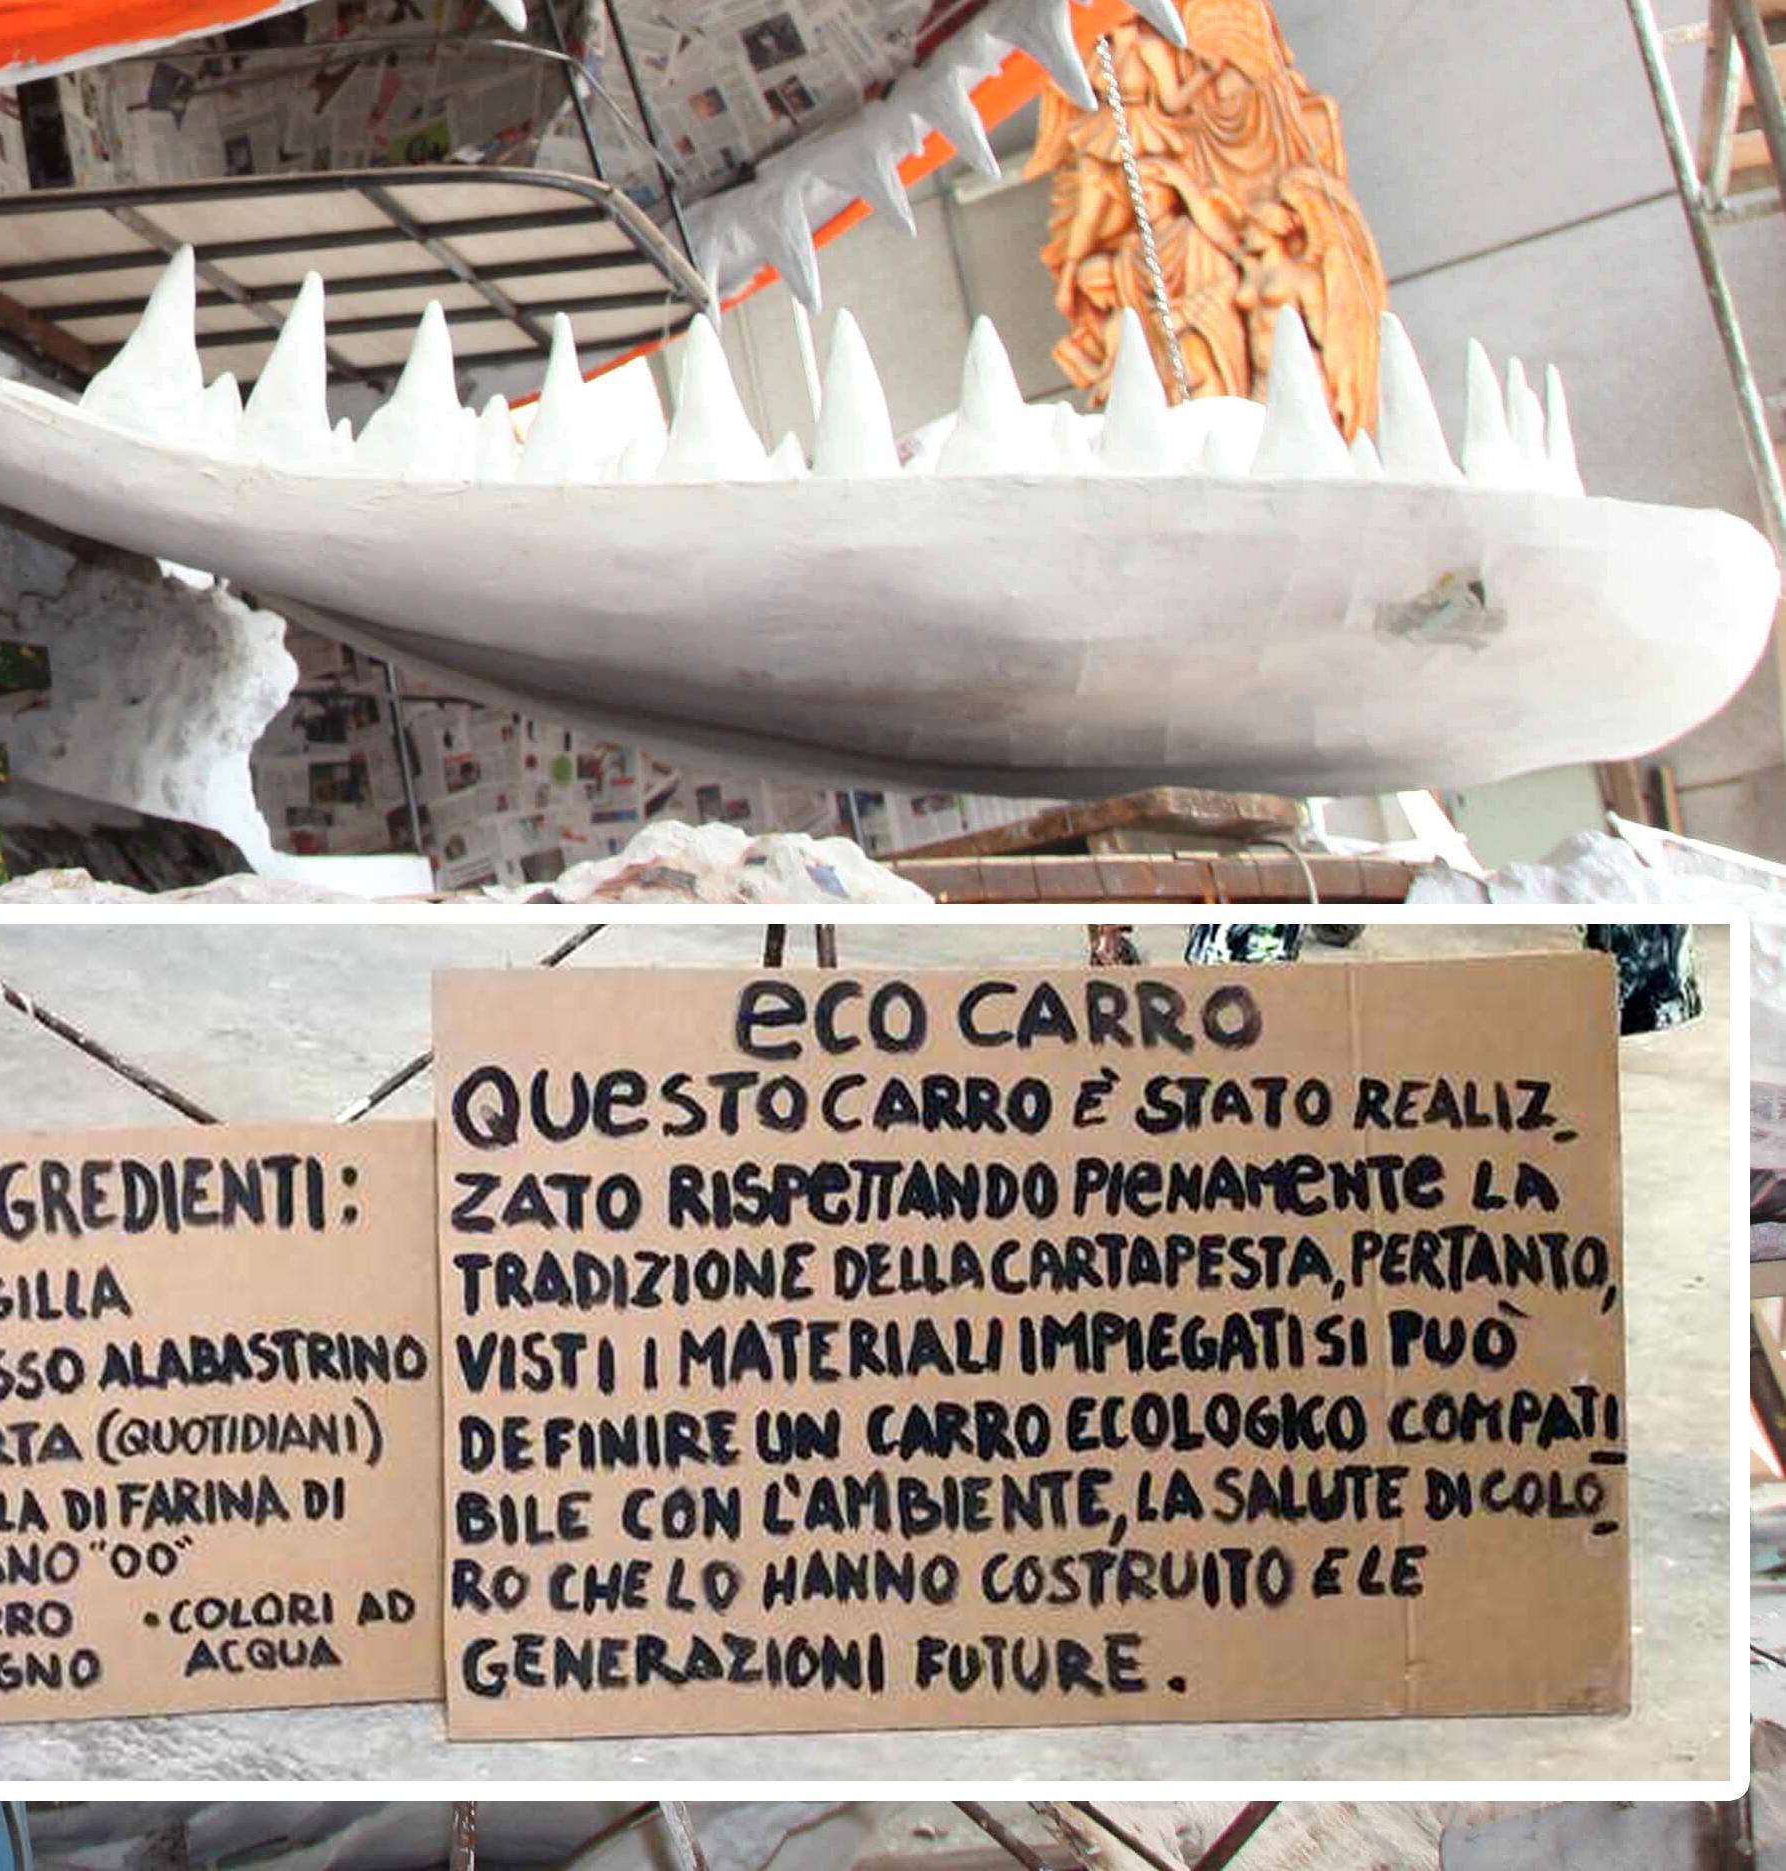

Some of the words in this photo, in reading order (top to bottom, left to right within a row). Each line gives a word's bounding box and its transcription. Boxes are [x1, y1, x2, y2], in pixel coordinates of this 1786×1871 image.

[958, 981, 1262, 1053] CARRO
[821, 1073, 1052, 1133] CARRO
[1072, 1068, 1119, 1128] È
[1134, 1075, 1333, 1135] STATO
[451, 1172, 643, 1233] ZATO
[1472, 1159, 1560, 1212] LA
[453, 1241, 816, 1315] TRADIZIONE
[833, 1241, 985, 1300] DELLA
[991, 1232, 1346, 1301] CARTAPESTA,
[1350, 1224, 1618, 1314] PERTANTO,
[98, 1329, 429, 1391] ALABASTRINO
[455, 1332, 614, 1395] VISTI
[643, 1336, 658, 1390] I
[679, 1318, 1003, 1388] MATERIALI
[1019, 1307, 1305, 1373] IMPIEGATI
[1317, 1313, 1368, 1369] SI
[1388, 1301, 1528, 1368] PUÒ
[97, 1397, 384, 1466] (QUOTIDIANI)
[457, 1409, 741, 1475] DEFINIRE
[755, 1409, 840, 1465] UN
[865, 1401, 1051, 1462] CARRO
[1065, 1392, 1367, 1452] ECOLOGICO
[64, 1486, 107, 1529] DI
[117, 1474, 289, 1528] FARINA
[304, 1477, 345, 1522] DI
[455, 1490, 592, 1546] BILE
[620, 1487, 742, 1541] CON
[762, 1470, 1128, 1546] L'AMBIENTE,
[1136, 1469, 1203, 1524] LA
[1213, 1464, 1411, 1524] SALUTE
[1425, 1467, 1471, 1520] DI
[169, 1591, 333, 1635] COLORI
[356, 1588, 417, 1627] AD
[451, 1557, 531, 1614] RO
[548, 1558, 654, 1615] CHE
[666, 1557, 743, 1614] LO
[762, 1549, 960, 1611] HANNO
[981, 1545, 1295, 1609] COSTRUITO
[1311, 1547, 1349, 1598] E
[1357, 1544, 1429, 1598] LE
[183, 1635, 342, 1678] ACQUA
[461, 1632, 885, 1700] GENERAZIONI
